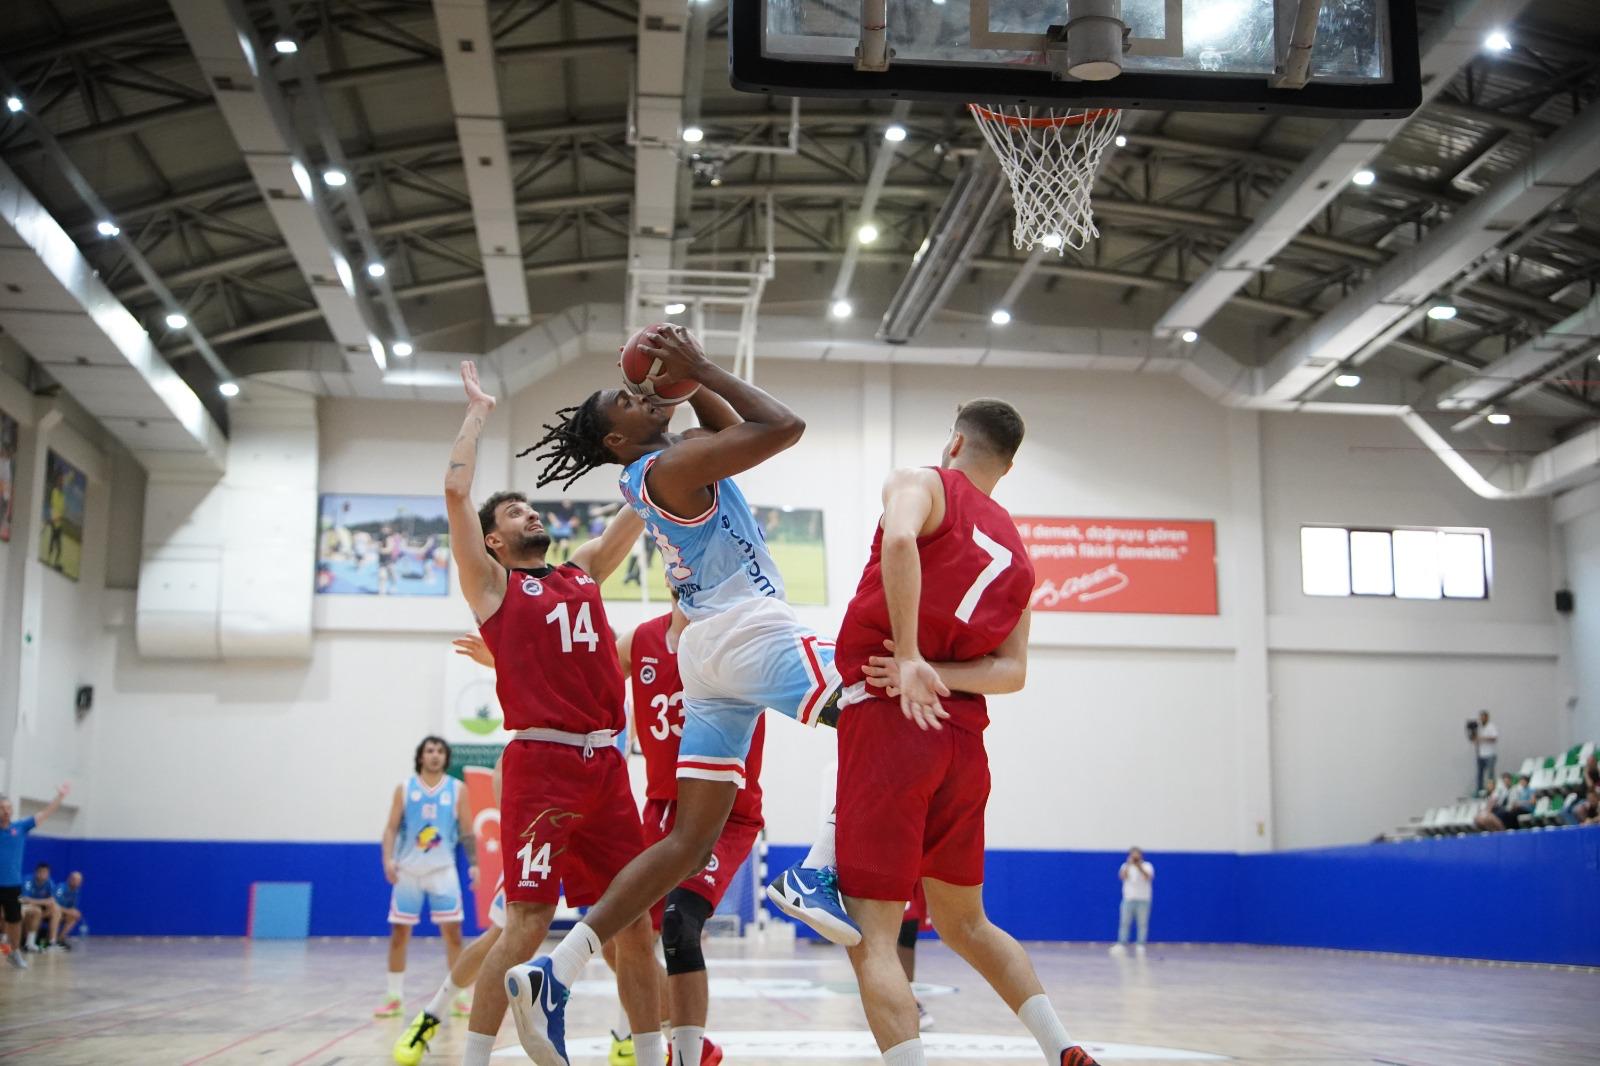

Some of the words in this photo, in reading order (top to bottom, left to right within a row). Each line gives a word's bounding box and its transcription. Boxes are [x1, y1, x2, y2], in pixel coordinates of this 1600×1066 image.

[954, 523, 1013, 624] 7
[545, 601, 599, 653] 14
[650, 691, 685, 740] 33
[516, 842, 552, 880] 14
